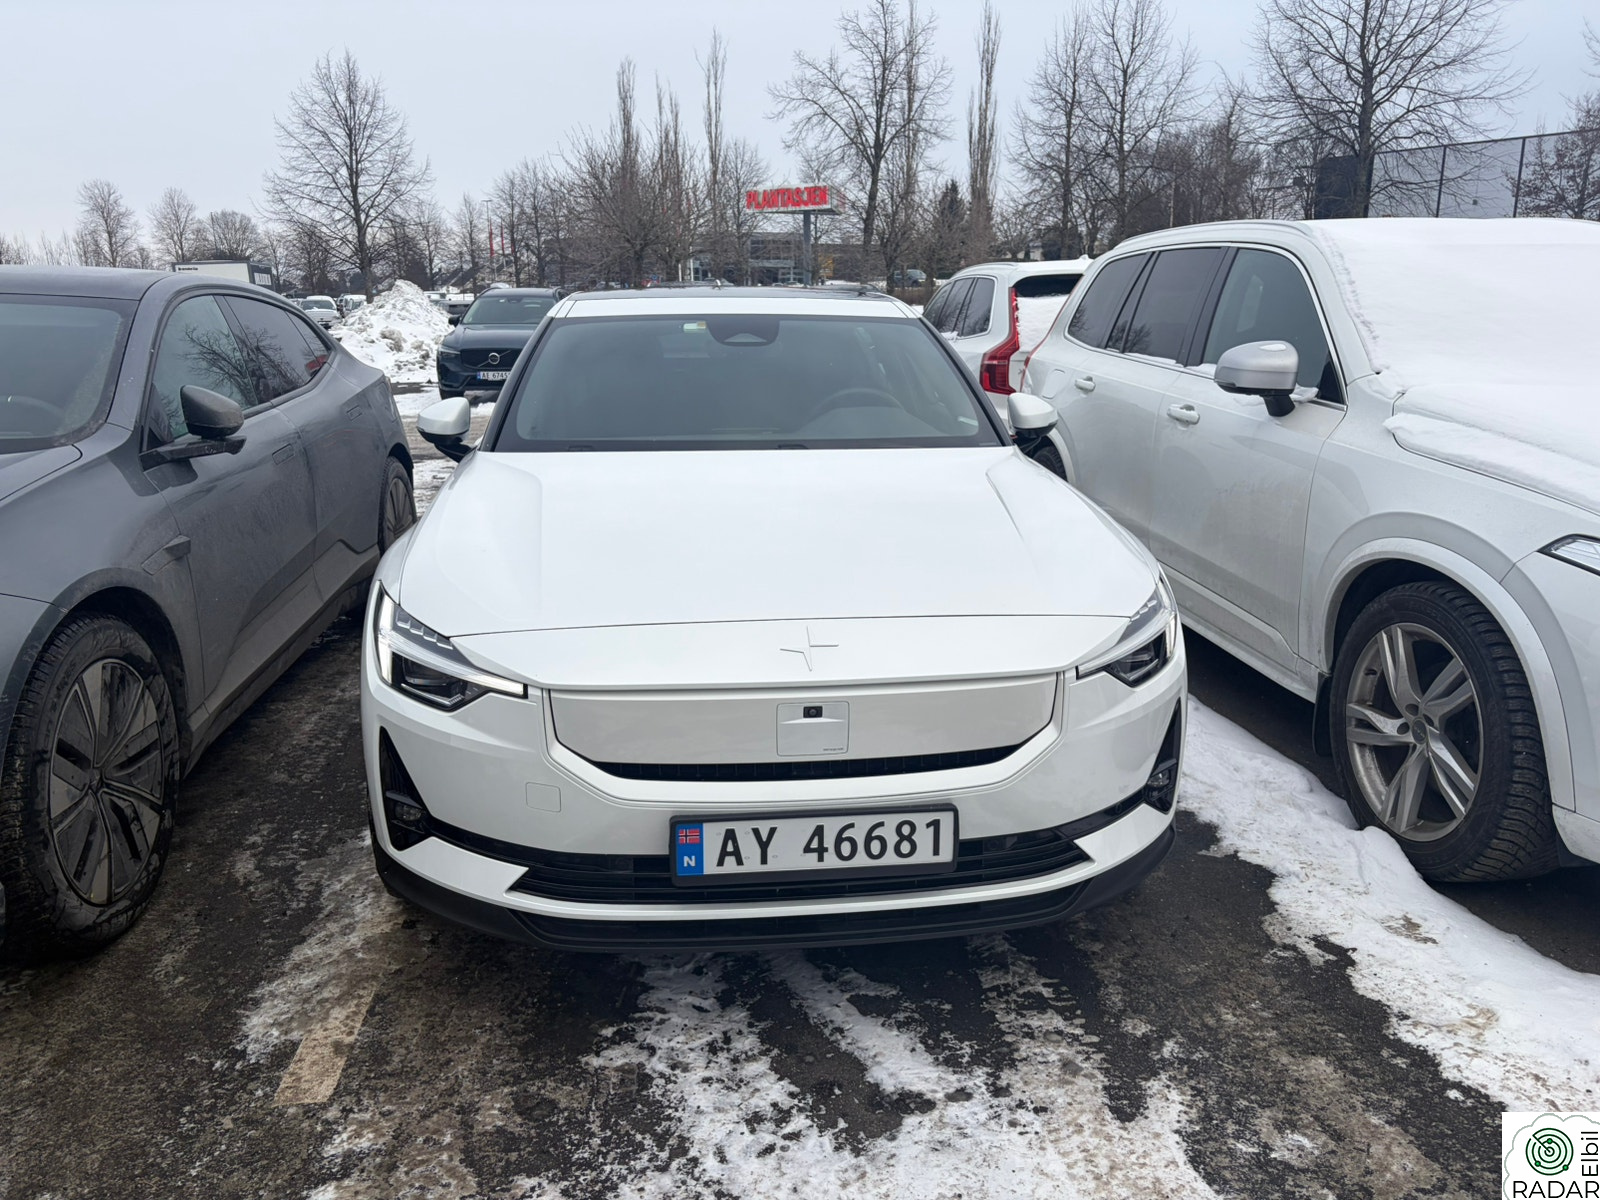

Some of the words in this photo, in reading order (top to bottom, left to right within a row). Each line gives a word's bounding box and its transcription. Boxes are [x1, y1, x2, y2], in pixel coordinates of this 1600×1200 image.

[746, 186, 828, 209] PLANTASJEN
[716, 826, 778, 867] AY
[802, 818, 941, 863] 46681
[683, 855, 696, 867] N
